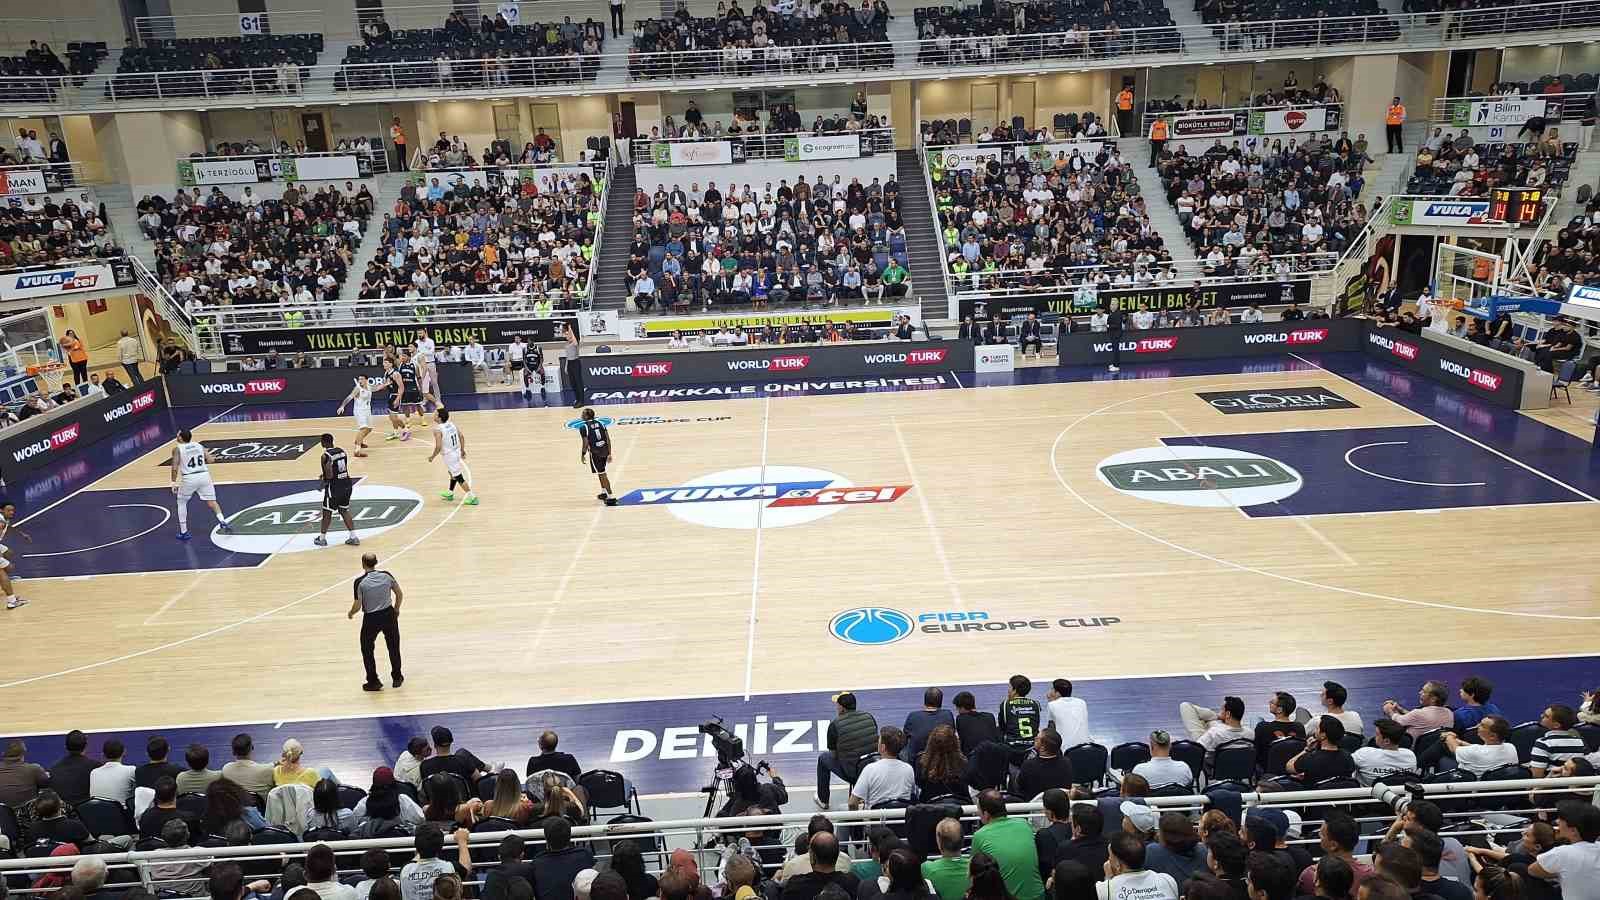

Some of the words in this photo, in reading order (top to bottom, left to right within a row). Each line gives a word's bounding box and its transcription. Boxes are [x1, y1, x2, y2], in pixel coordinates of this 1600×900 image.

[241, 16, 259, 31] G1
[1494, 103, 1521, 113] Bilim
[1490, 127, 1503, 138] D1
[207, 168, 255, 178] TERZİOĞLU
[1494, 203, 1506, 219] 14
[1520, 203, 1536, 220] 14
[307, 331, 371, 349] YUKATEL
[435, 327, 487, 344] BASKET
[1244, 333, 1287, 344] WORLD
[1291, 330, 1323, 342] TURK
[1140, 339, 1172, 350] TURK
[1370, 333, 1394, 350] WORLD
[1394, 342, 1415, 359] TURK
[727, 360, 770, 370] WORLD
[773, 358, 805, 368] TURK
[864, 354, 907, 364] WORLD
[911, 351, 942, 362] TURK
[589, 366, 632, 376] WORLD
[637, 364, 669, 374] TURK
[1440, 358, 1470, 379] WORLD
[1473, 370, 1497, 389] TURK
[201, 382, 245, 394] WORLD
[249, 380, 282, 392] TURK
[590, 384, 756, 401] PAMUKKALE
[764, 375, 947, 392] ÜNİVERSİTESİ
[103, 402, 133, 422] WORLD
[133, 393, 153, 409] TURK
[1210, 394, 1343, 407] GLORIA
[13, 438, 51, 462] WORLD
[52, 428, 78, 445] TURK
[187, 455, 203, 468] 46
[1131, 464, 1273, 483] ABALI
[918, 611, 990, 623] FIBA
[920, 619, 1050, 634] EUROPE
[1058, 616, 1121, 628] CUP
[1018, 717, 1033, 738] 5
